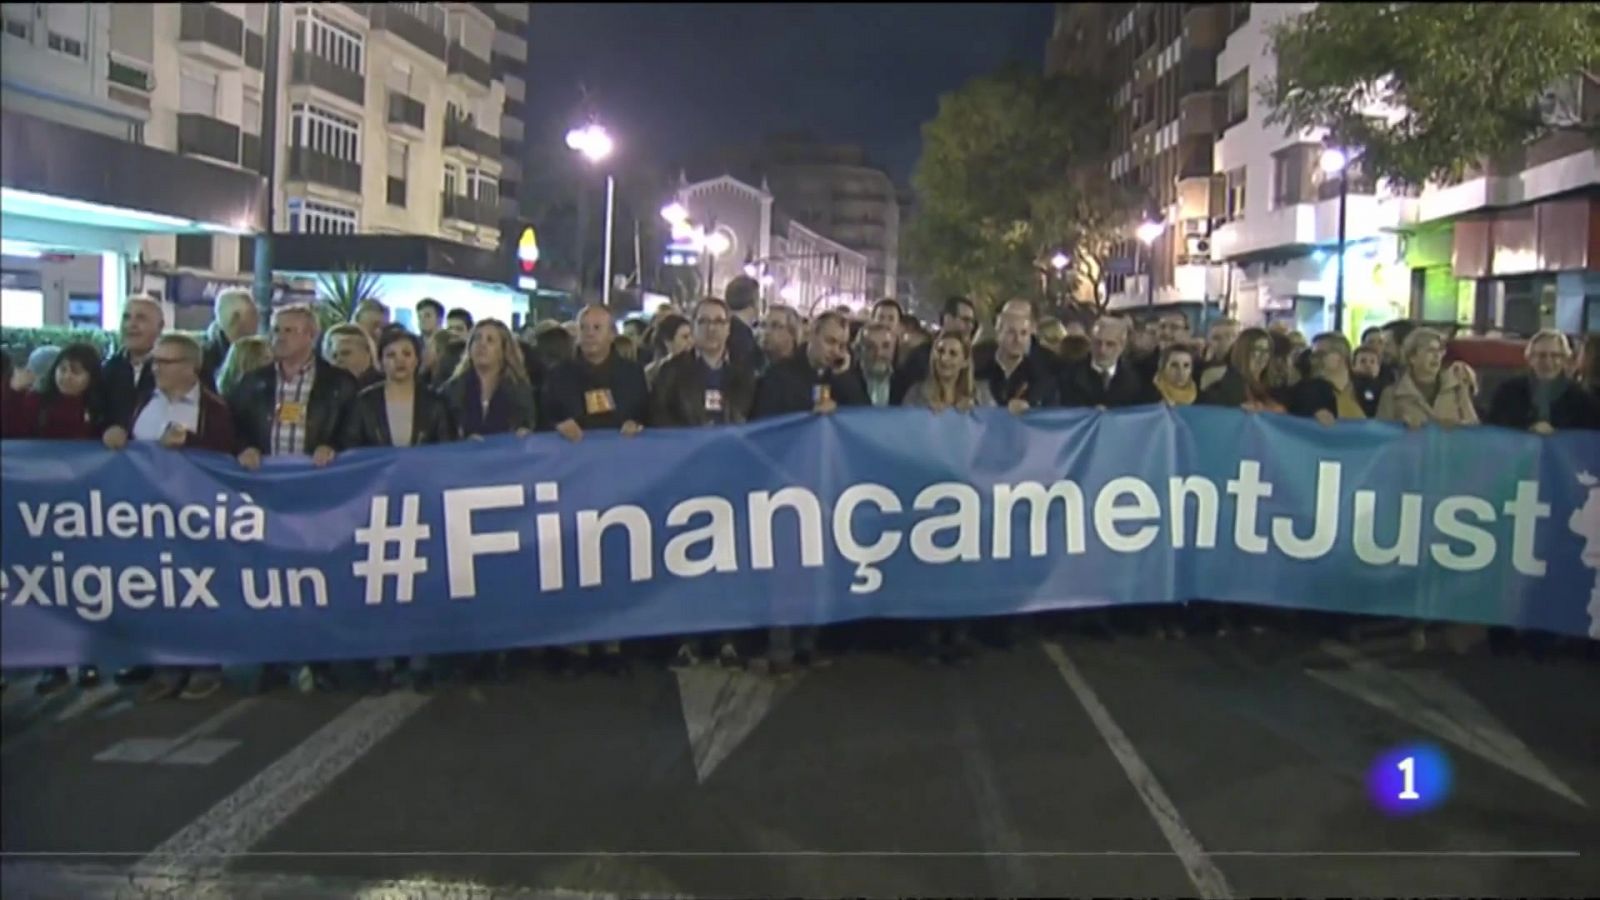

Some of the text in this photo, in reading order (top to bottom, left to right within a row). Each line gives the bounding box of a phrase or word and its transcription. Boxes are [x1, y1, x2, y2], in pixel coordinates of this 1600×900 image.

[18, 490, 265, 541] valencià
[352, 460, 1551, 604] #FinançamentJust
[0, 551, 328, 621] xigeix un
